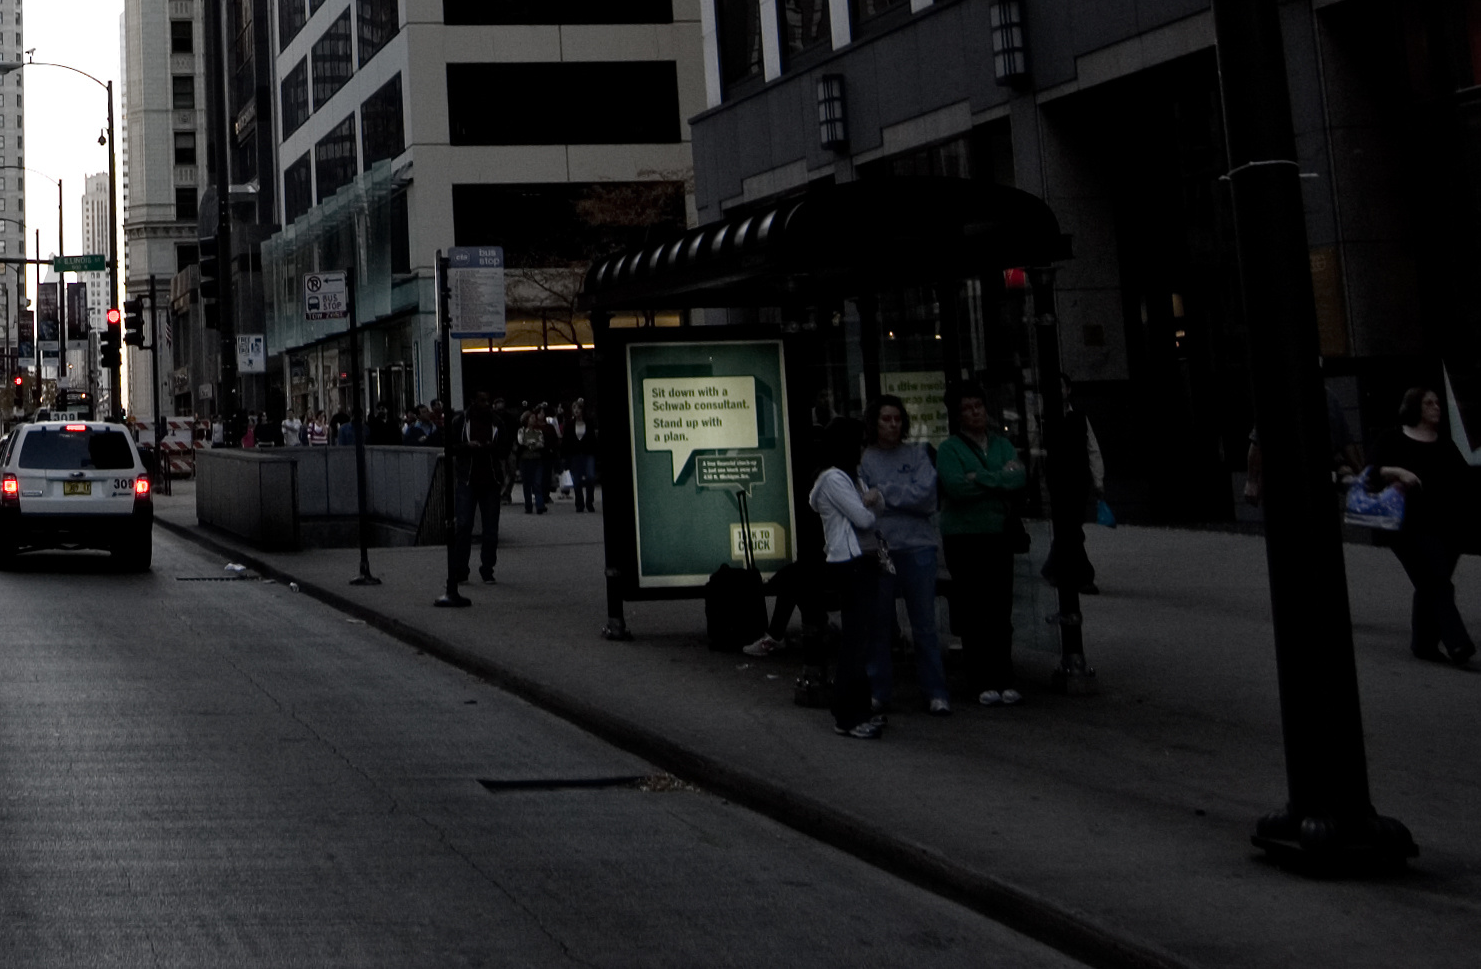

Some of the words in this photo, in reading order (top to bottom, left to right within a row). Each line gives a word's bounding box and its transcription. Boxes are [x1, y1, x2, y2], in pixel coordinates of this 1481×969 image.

[478, 248, 497, 257] bus
[64, 257, 92, 265] ILLINOIS
[478, 257, 500, 267] stop
[322, 294, 338, 302] BUS
[323, 302, 342, 310] STOP
[651, 387, 666, 398] Sit
[668, 387, 695, 398] down
[697, 386, 719, 397] with
[722, 388, 728, 397] a
[652, 400, 692, 411] Schwab
[694, 399, 750, 410] consultant.
[653, 417, 683, 429] Stand
[686, 419, 699, 430] up
[701, 416, 723, 427] with
[654, 433, 661, 442] a
[663, 431, 689, 443] plan.
[738, 530, 757, 540] TK
[760, 530, 770, 539] TO
[738, 539, 770, 551] CUCK
